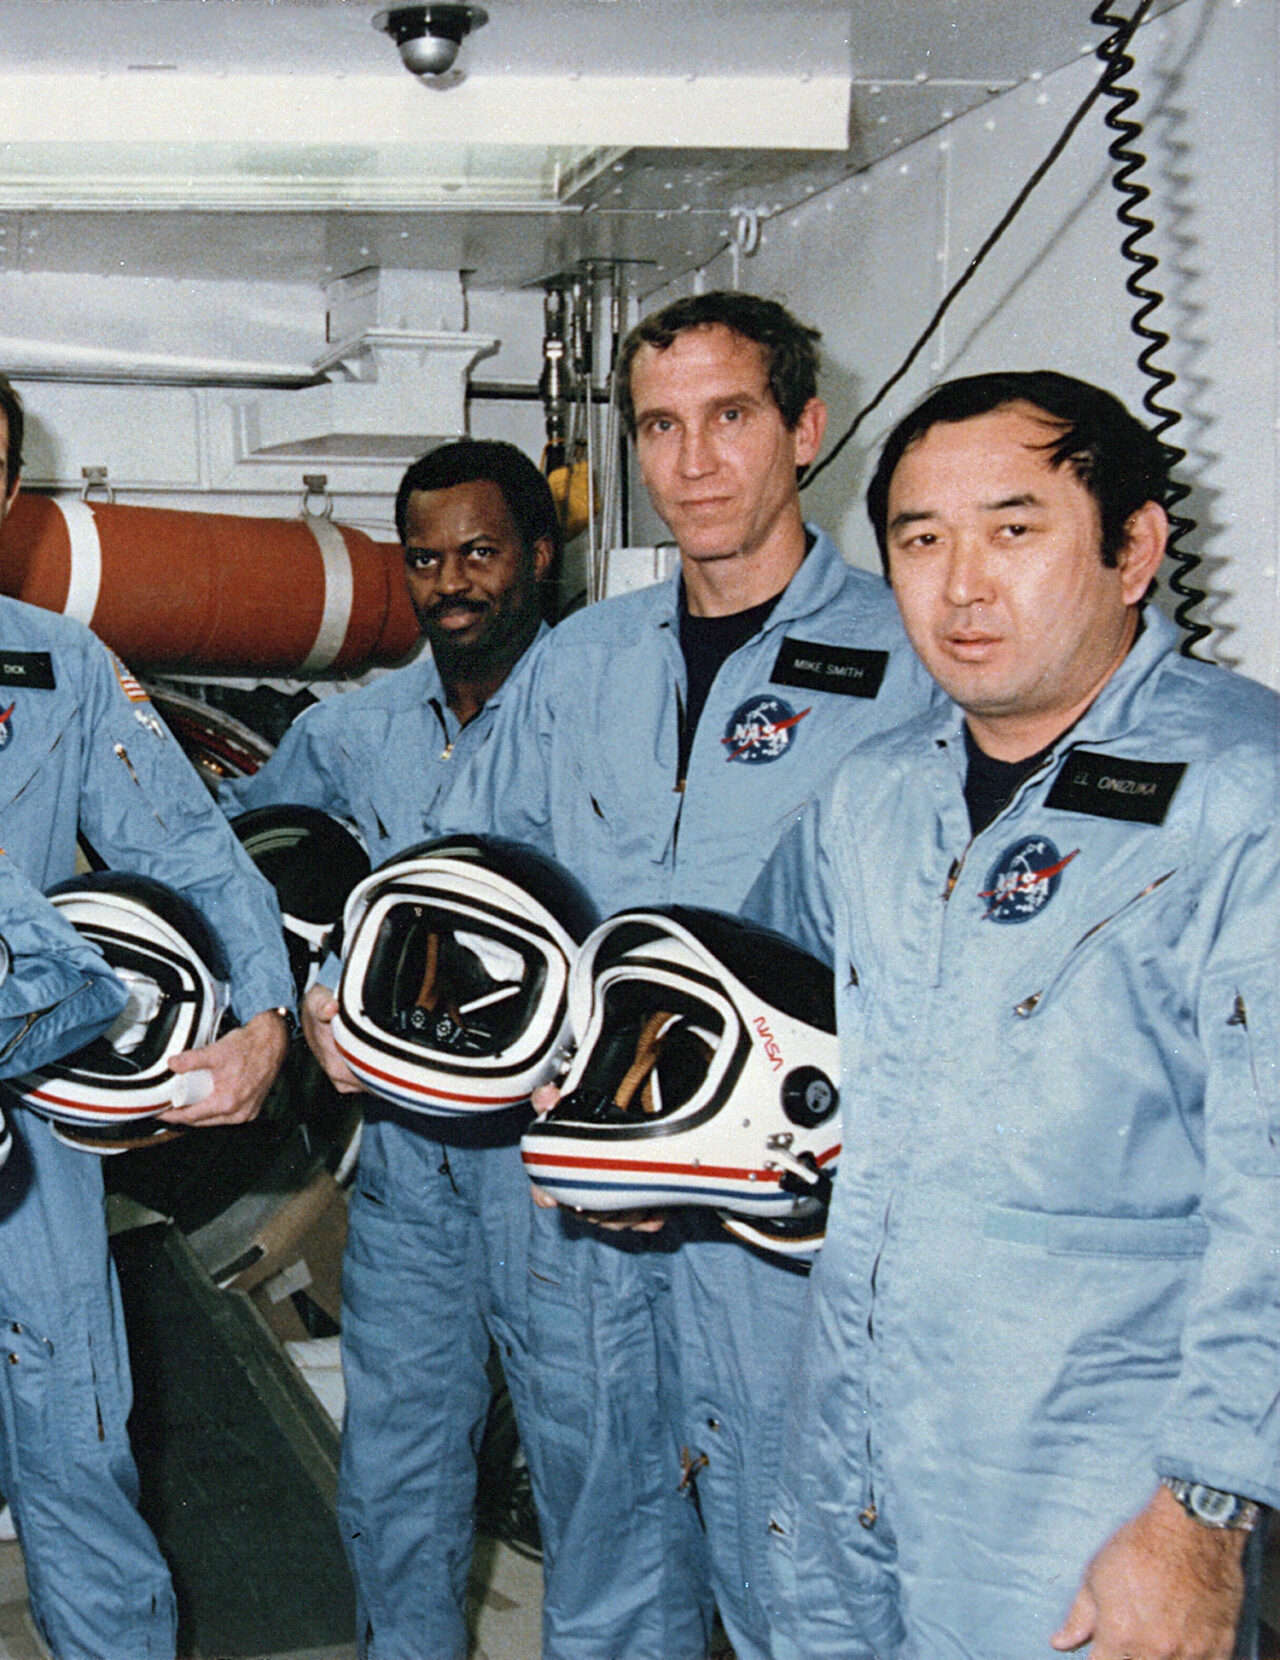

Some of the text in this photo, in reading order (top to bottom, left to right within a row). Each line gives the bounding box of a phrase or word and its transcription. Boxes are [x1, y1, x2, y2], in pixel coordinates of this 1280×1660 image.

[3, 664, 26, 675] DICK
[793, 659, 864, 678] MIKE SMITH
[752, 1016, 784, 1072] NASA
